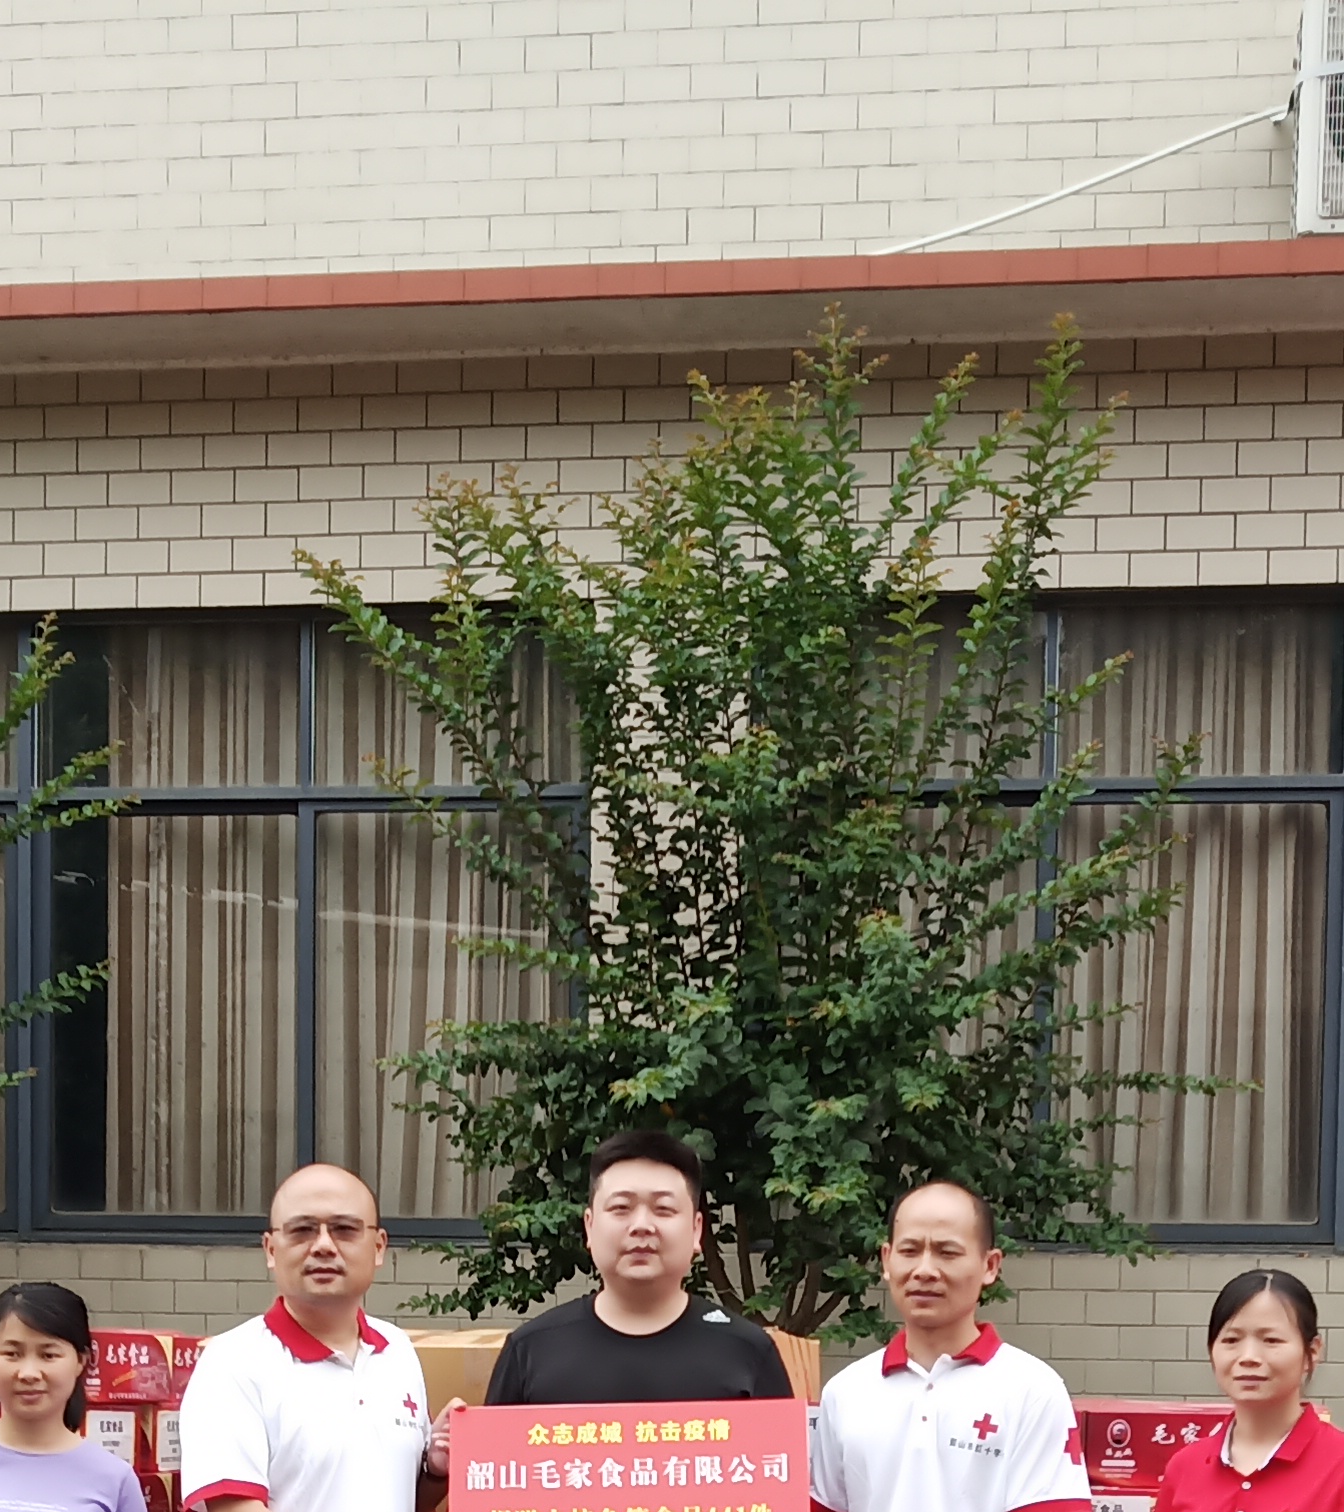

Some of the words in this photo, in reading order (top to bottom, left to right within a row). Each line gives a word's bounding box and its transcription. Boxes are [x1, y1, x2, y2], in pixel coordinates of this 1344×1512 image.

[528, 1422, 622, 1445] 众志成城
[636, 1418, 731, 1443] 抗击疫情
[466, 1453, 789, 1491] 韶山毛家食品有限公司
